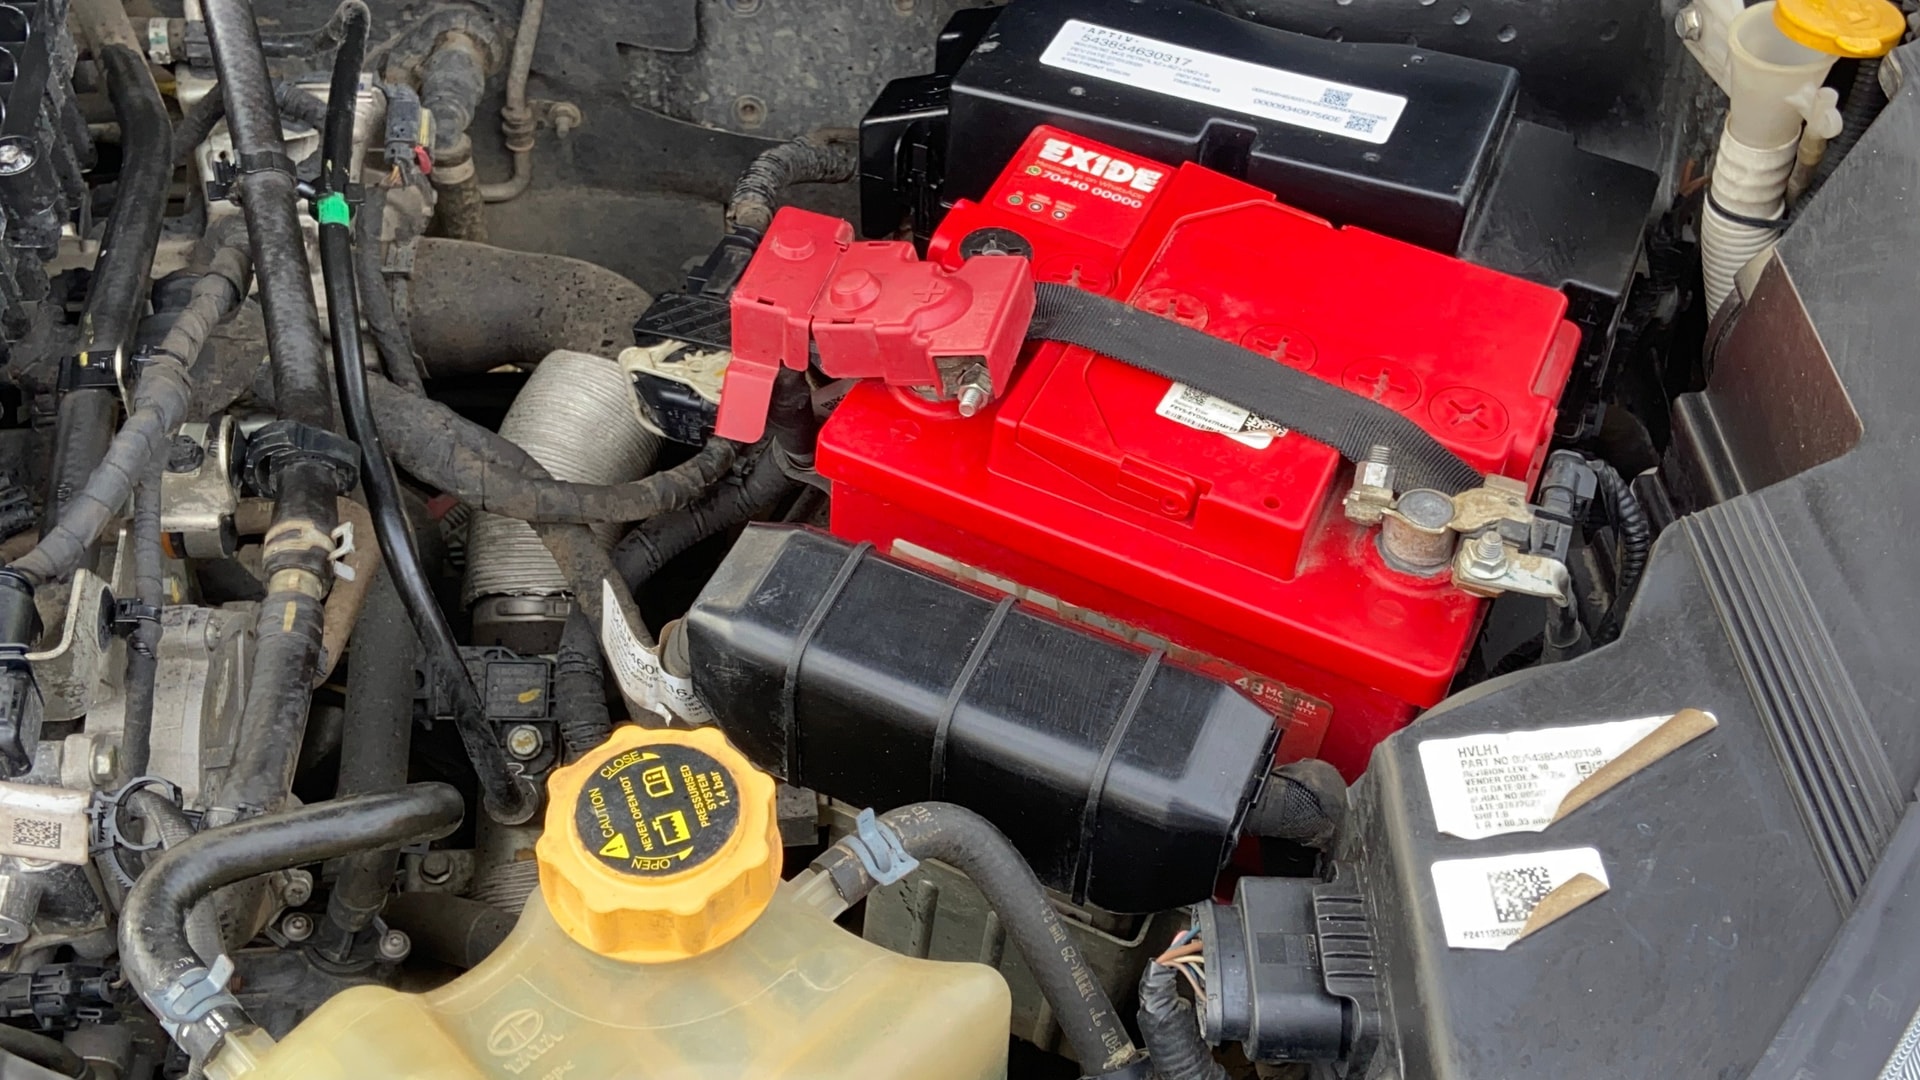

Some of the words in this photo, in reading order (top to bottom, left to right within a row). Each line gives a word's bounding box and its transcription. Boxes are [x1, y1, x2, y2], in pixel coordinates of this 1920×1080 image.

[1081, 34, 1193, 66] 543854630317
[1038, 138, 1164, 193] EXIDE
[1042, 170, 1089, 191] 70440
[1091, 186, 1143, 209] 00000
[1099, 177, 1146, 201] WhatsApp
[1234, 677, 1264, 696] 48
[1458, 744, 1500, 758] HVLH1
[1461, 758, 1489, 769] PART
[600, 751, 642, 778] CLOSE
[619, 776, 634, 795] HOT
[695, 773, 717, 810] SYSTEM
[710, 771, 724, 790] bar
[626, 794, 642, 820] OPEN
[680, 764, 711, 828] PRESSURISED
[715, 790, 730, 806] 1.4
[588, 788, 615, 838] CAUTION
[635, 820, 654, 851] NEVER
[631, 859, 671, 870] OPEN
